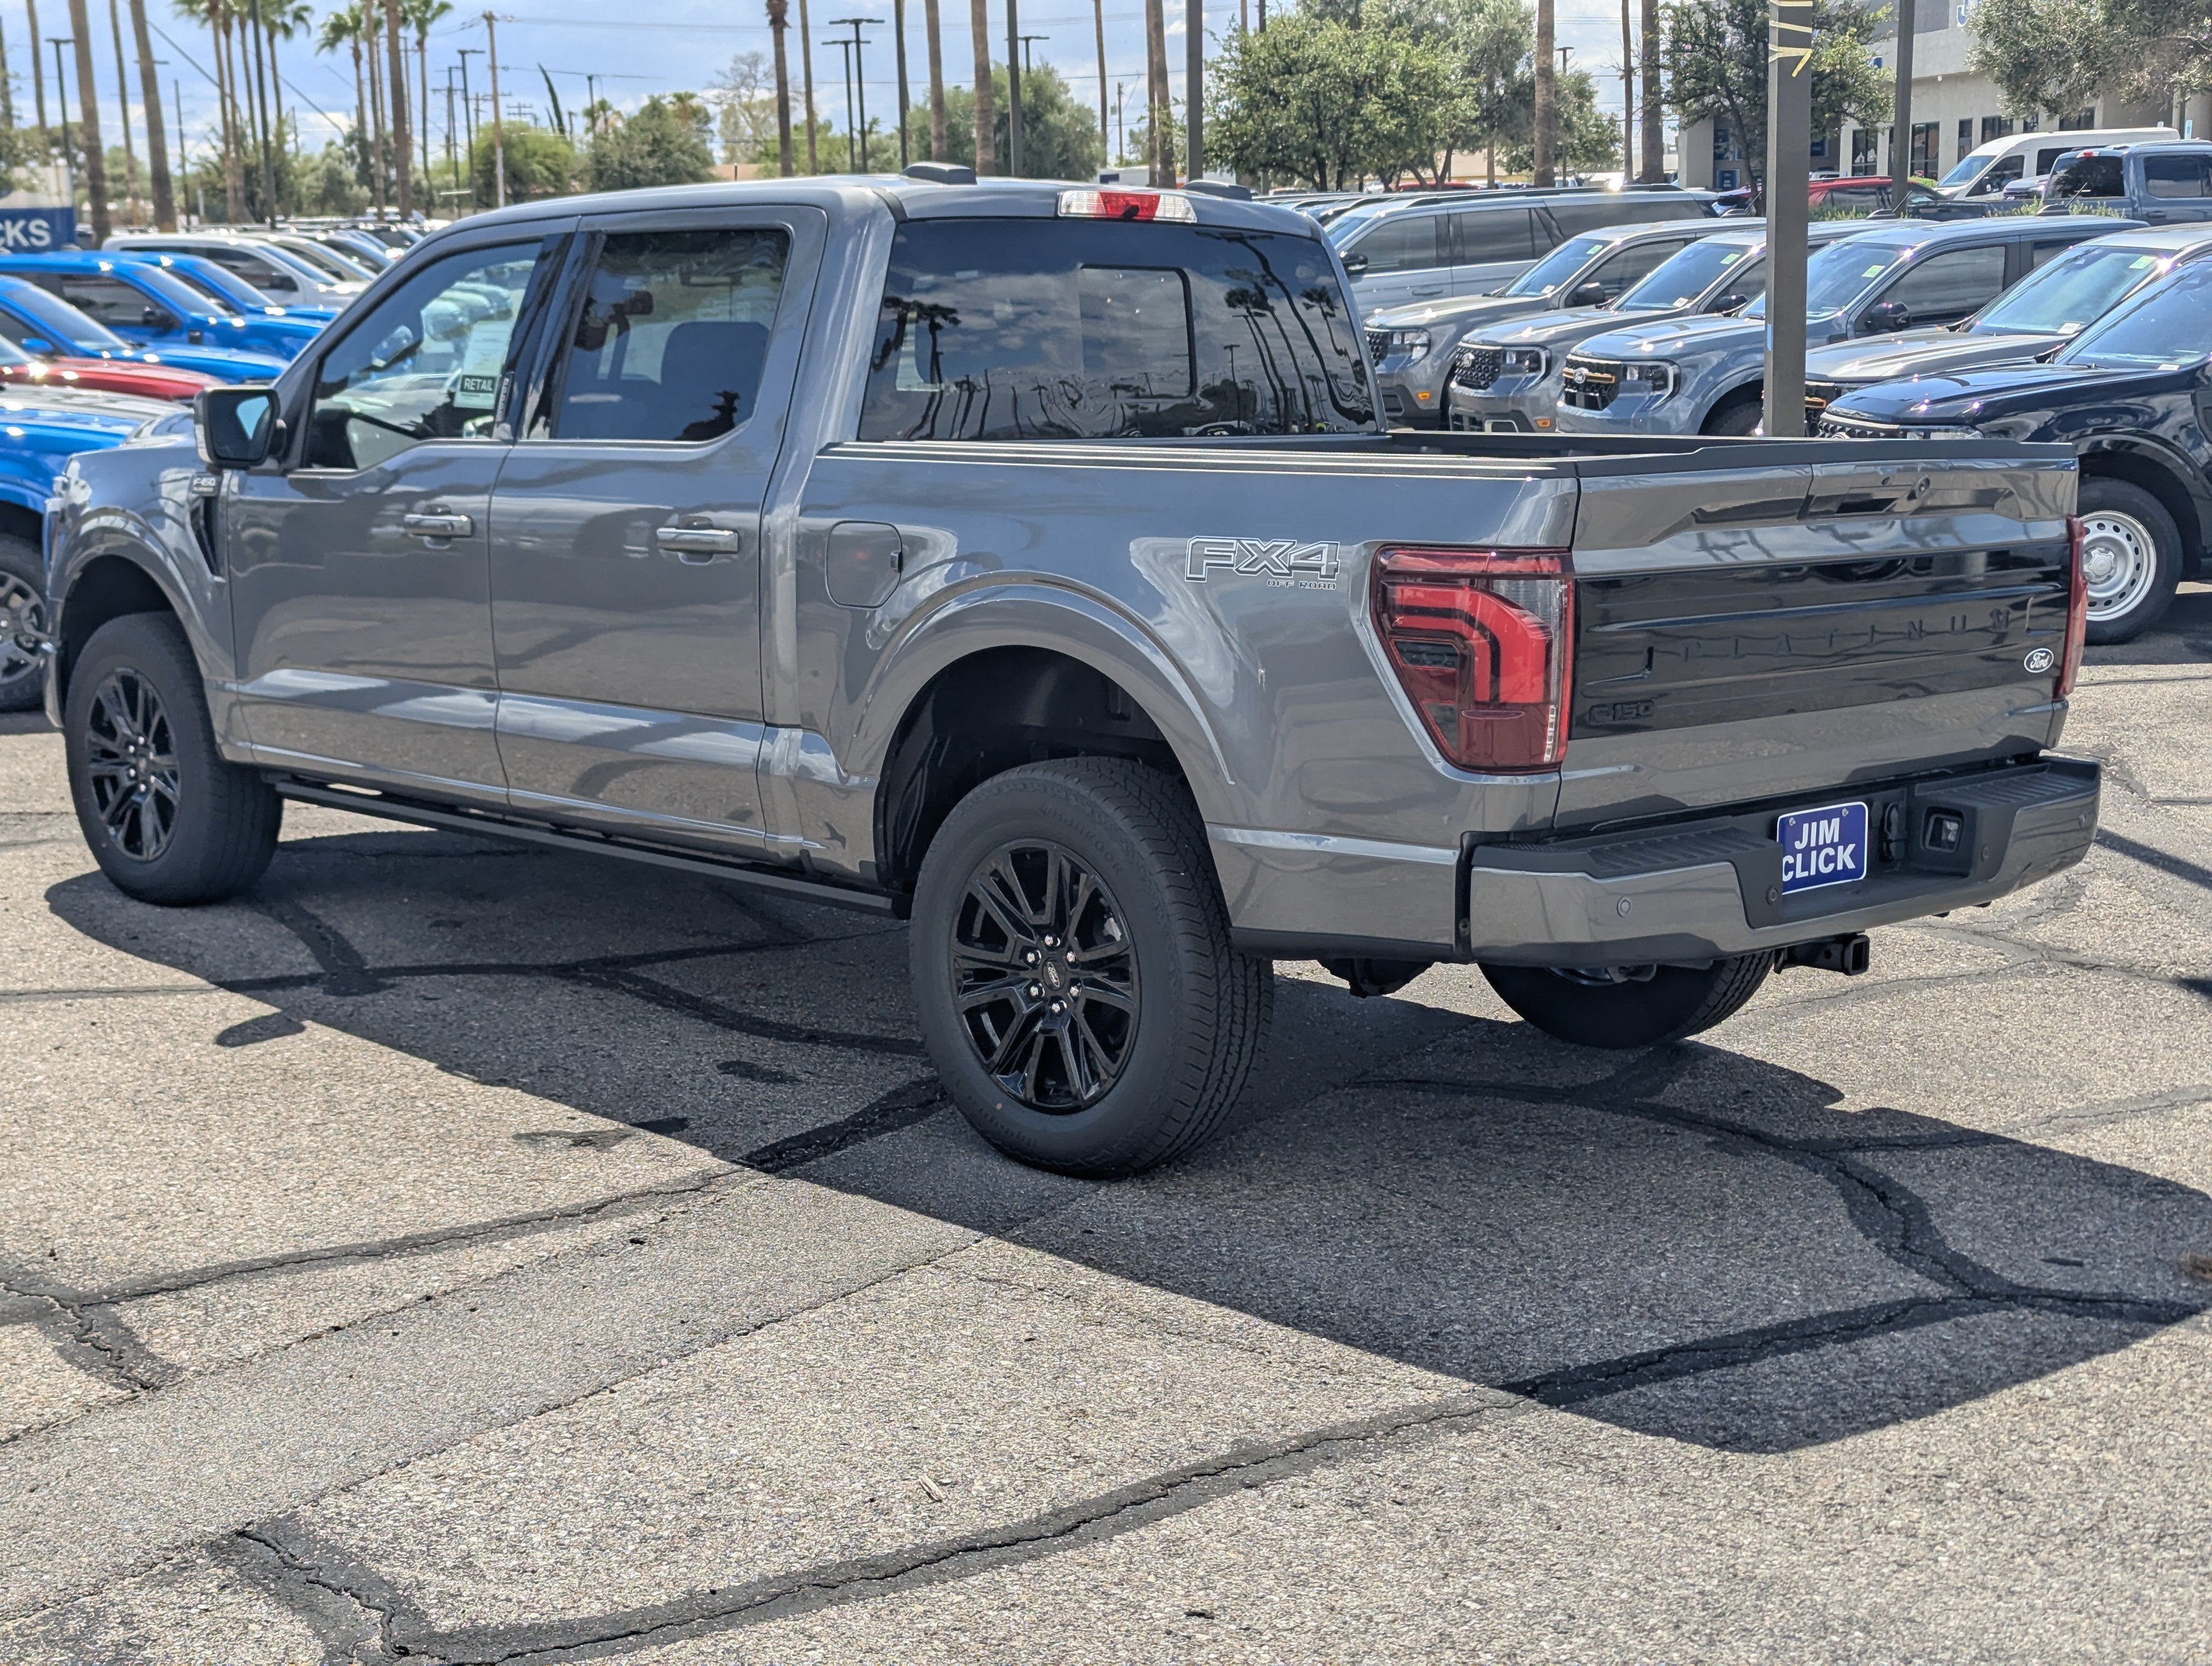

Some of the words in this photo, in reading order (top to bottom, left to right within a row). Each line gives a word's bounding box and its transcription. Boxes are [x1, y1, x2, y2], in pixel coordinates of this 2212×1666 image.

[0, 219, 52, 247] KS
[464, 377, 493, 392] RETAIL
[1184, 535, 1340, 582] FX4
[1266, 579, 1295, 588] OFF
[1299, 580, 1336, 591] ROAD
[2029, 651, 2050, 670] Ford
[1794, 817, 1840, 850] JIM
[1782, 843, 1856, 882] CLICK
